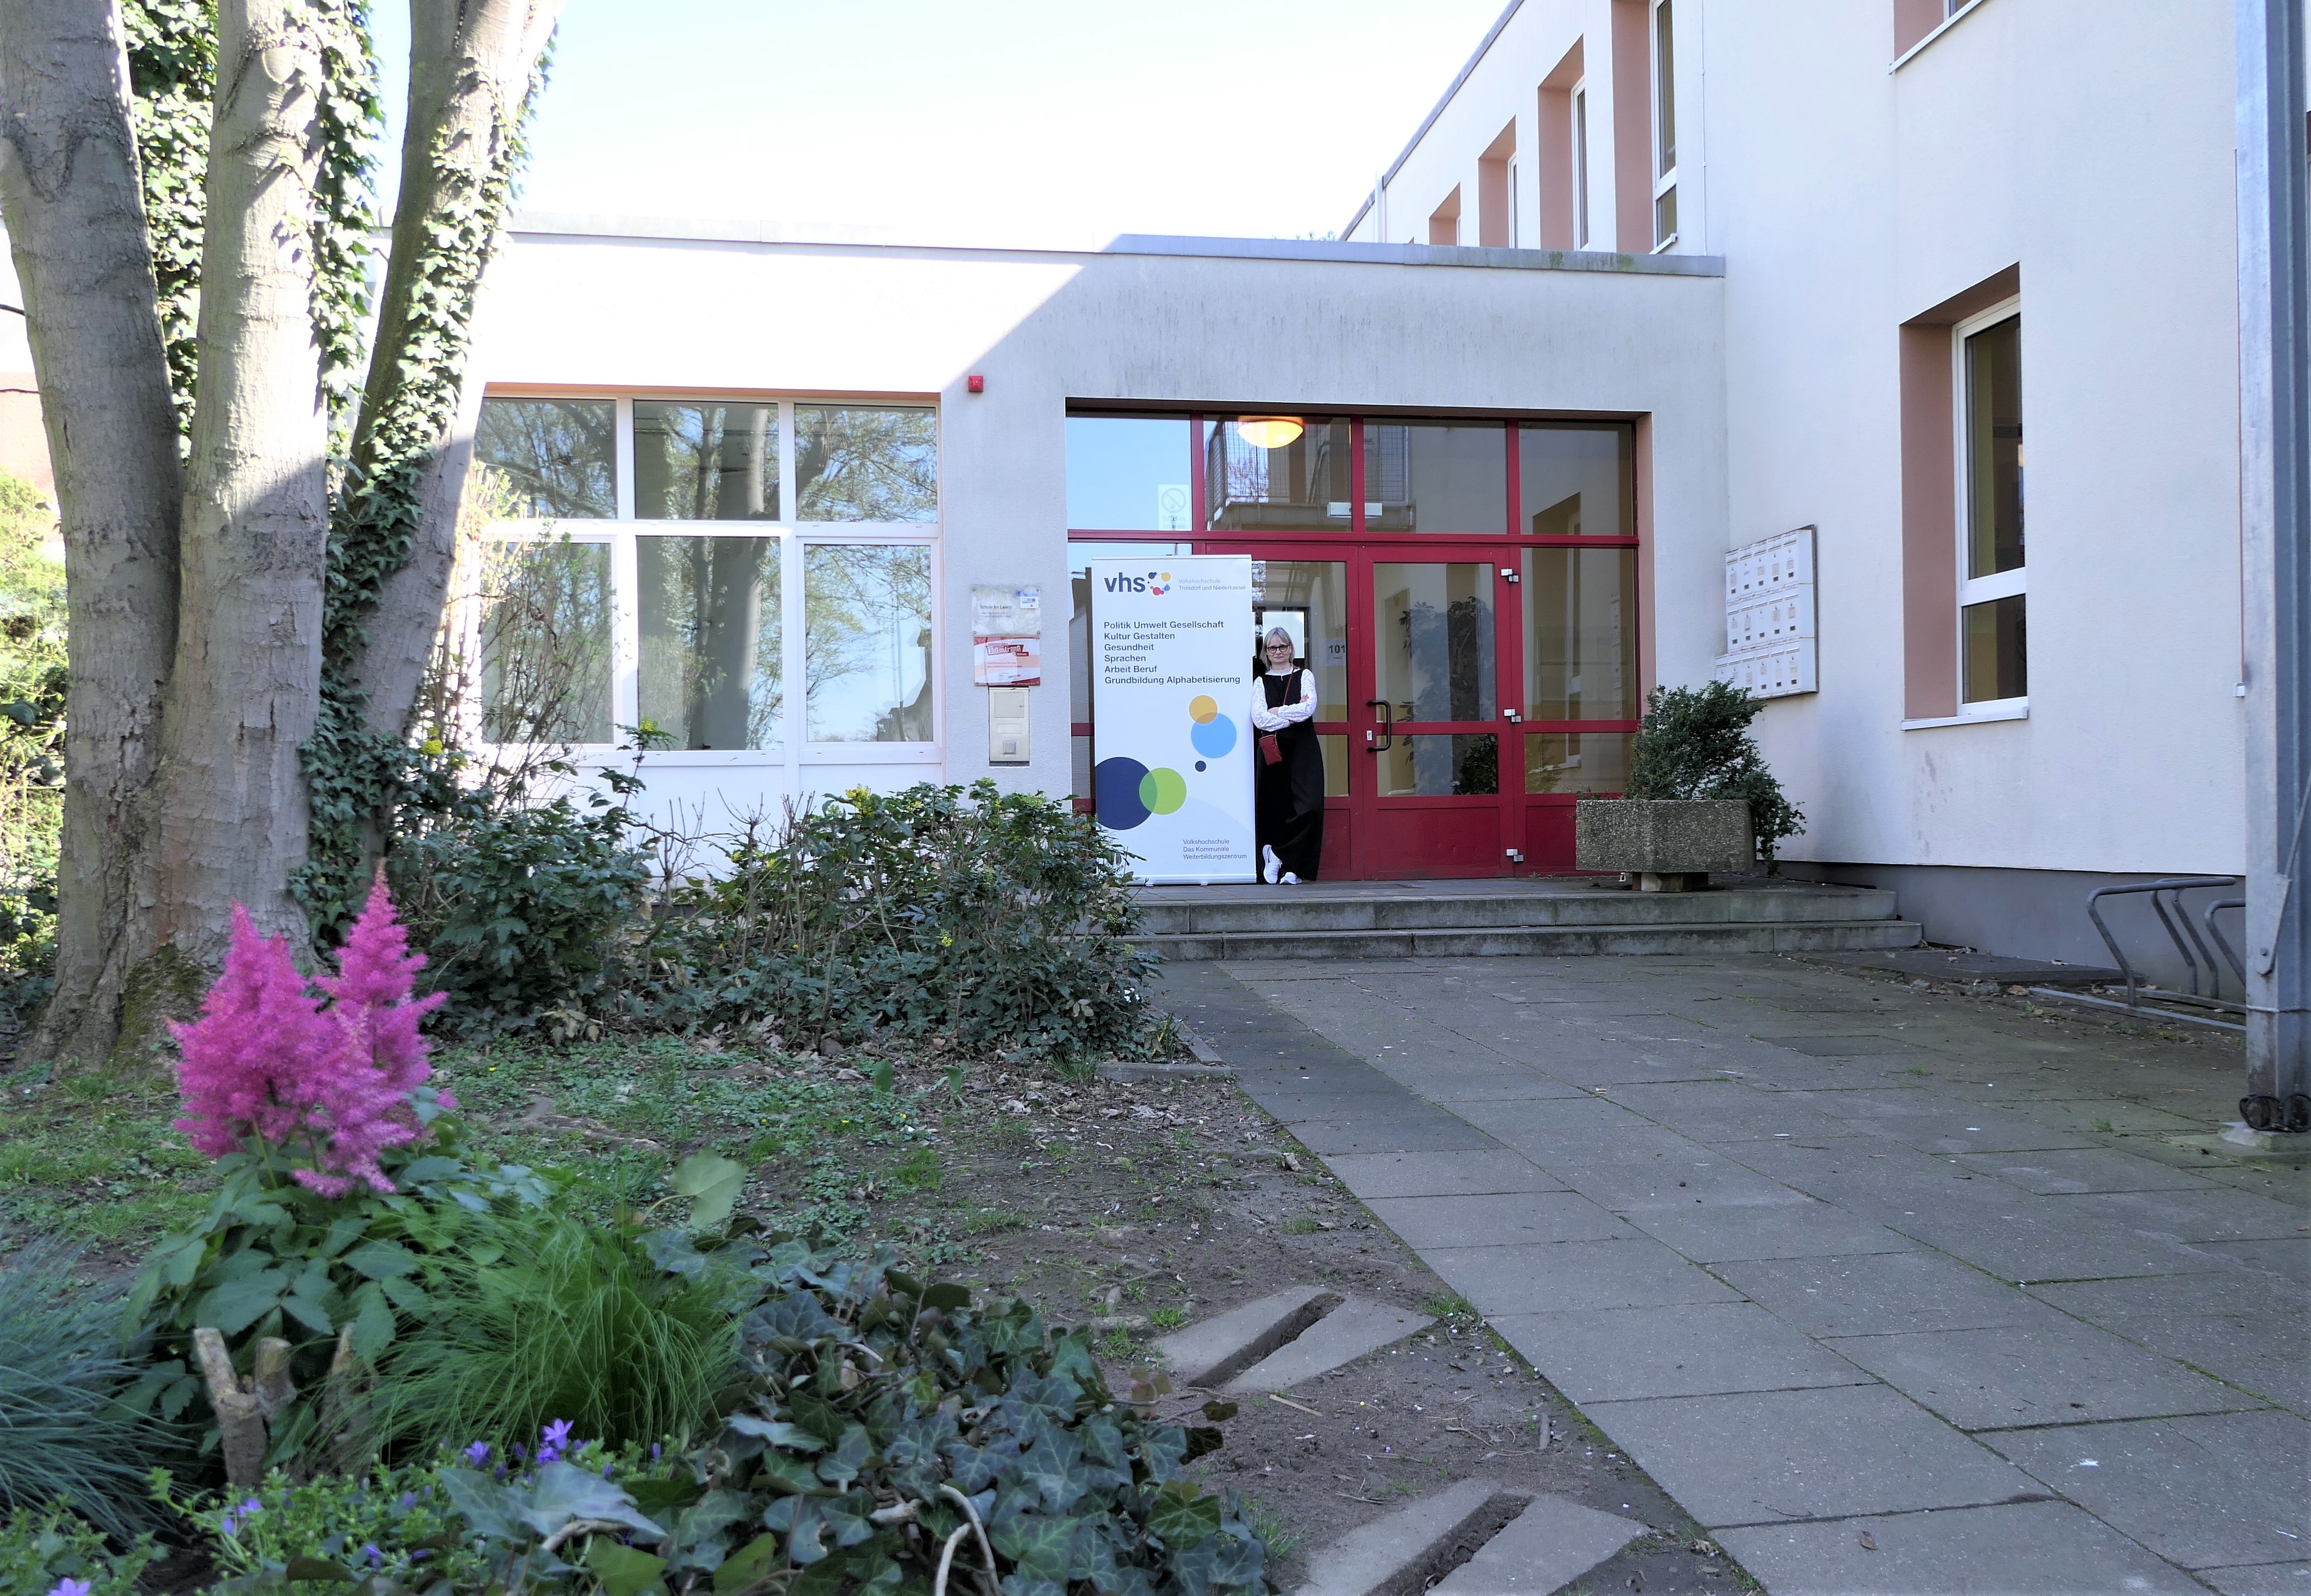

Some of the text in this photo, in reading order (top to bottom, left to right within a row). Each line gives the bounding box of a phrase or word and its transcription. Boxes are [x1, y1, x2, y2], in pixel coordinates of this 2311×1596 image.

[1104, 572, 1146, 593] vhs
[1329, 645, 1345, 653] 101
[1104, 654, 1146, 663] Sprachen
[1105, 676, 1240, 684] Grundbildung Alphabetisierung
